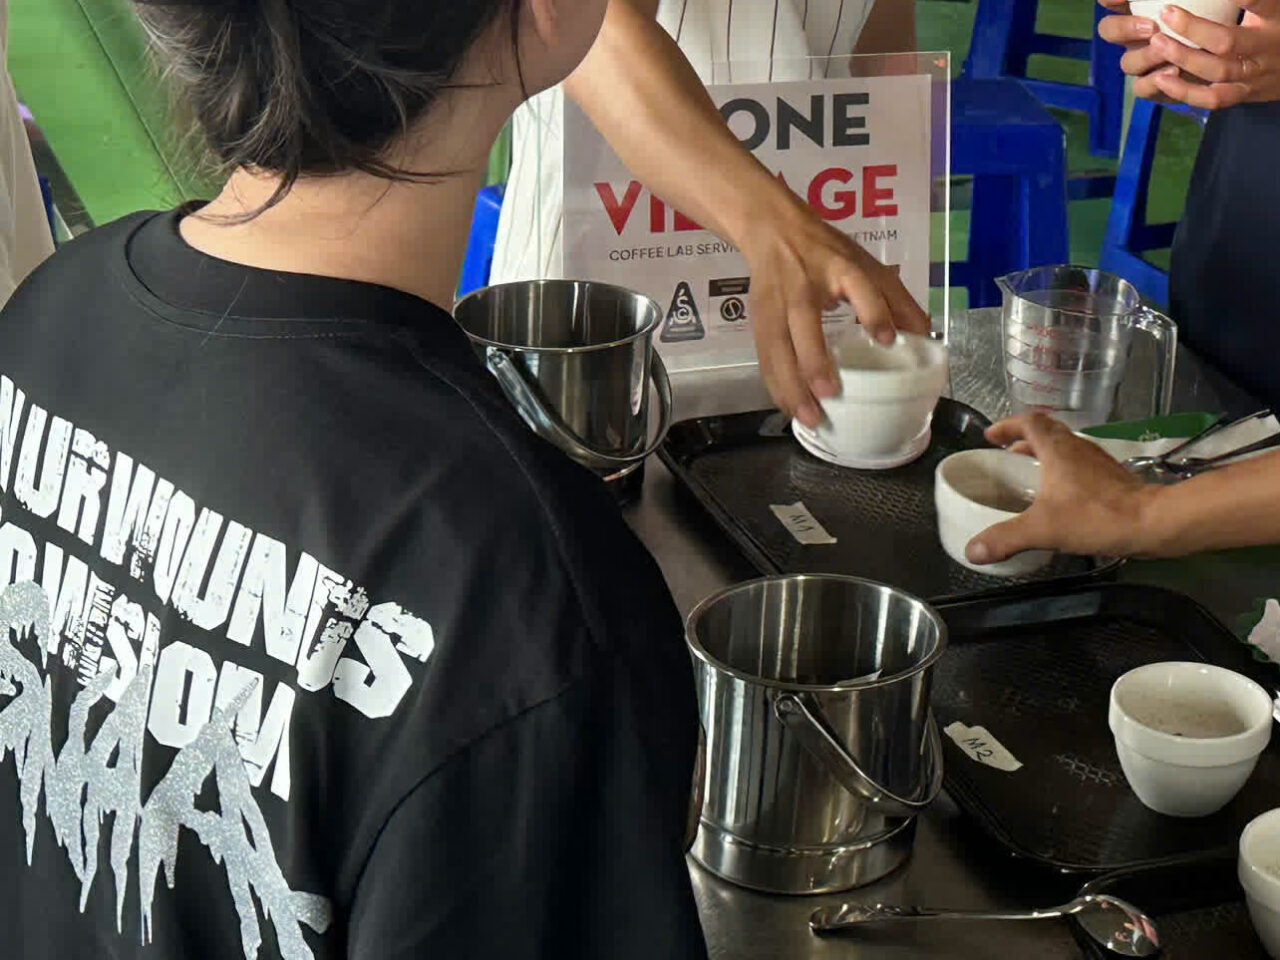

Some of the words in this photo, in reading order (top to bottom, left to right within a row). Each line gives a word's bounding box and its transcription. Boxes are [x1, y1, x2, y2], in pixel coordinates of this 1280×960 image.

[719, 92, 870, 151] ONE
[609, 244, 666, 261] COFFEE
[667, 243, 693, 258] LAB
[696, 240, 741, 255] SERVI
